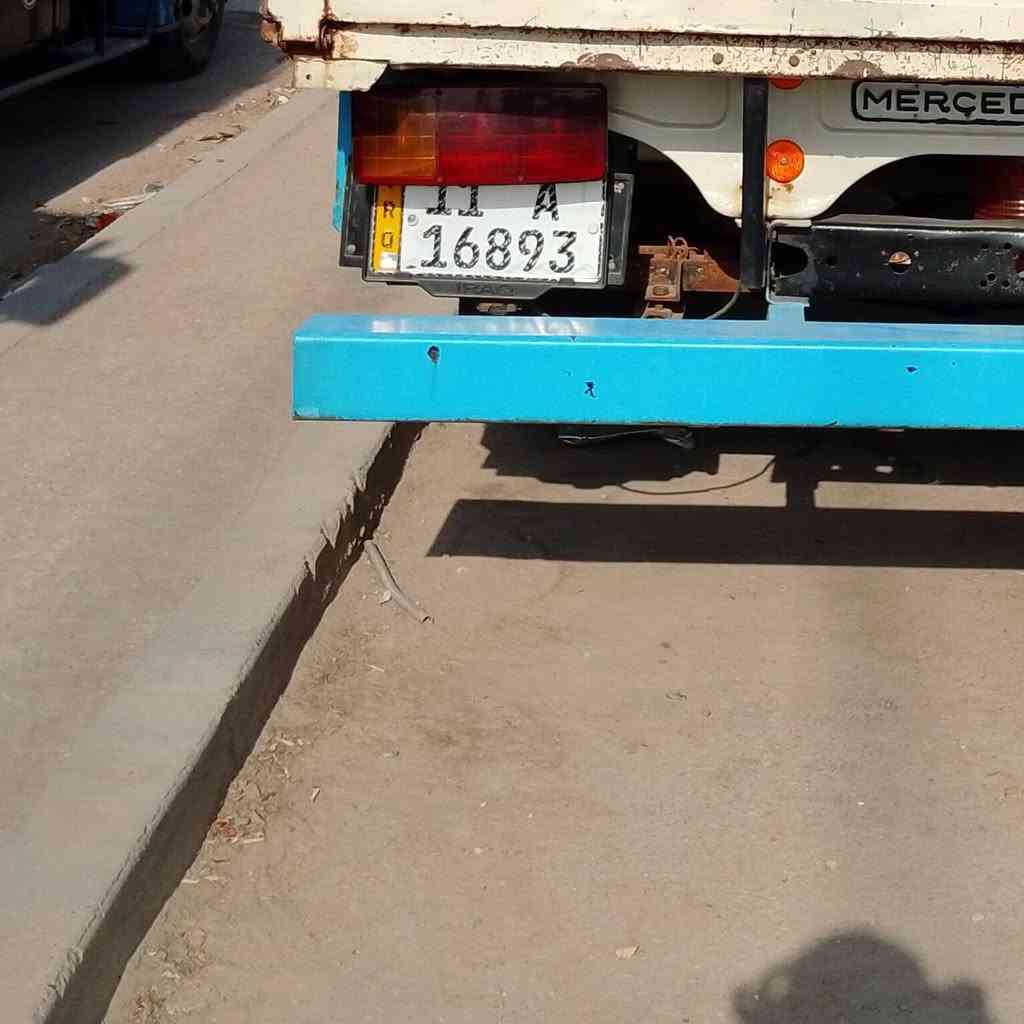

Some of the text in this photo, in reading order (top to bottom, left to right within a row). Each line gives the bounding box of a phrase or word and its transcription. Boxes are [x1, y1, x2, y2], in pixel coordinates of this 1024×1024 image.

[426, 184, 560, 221] 11 A
[420, 225, 577, 274] 16893
